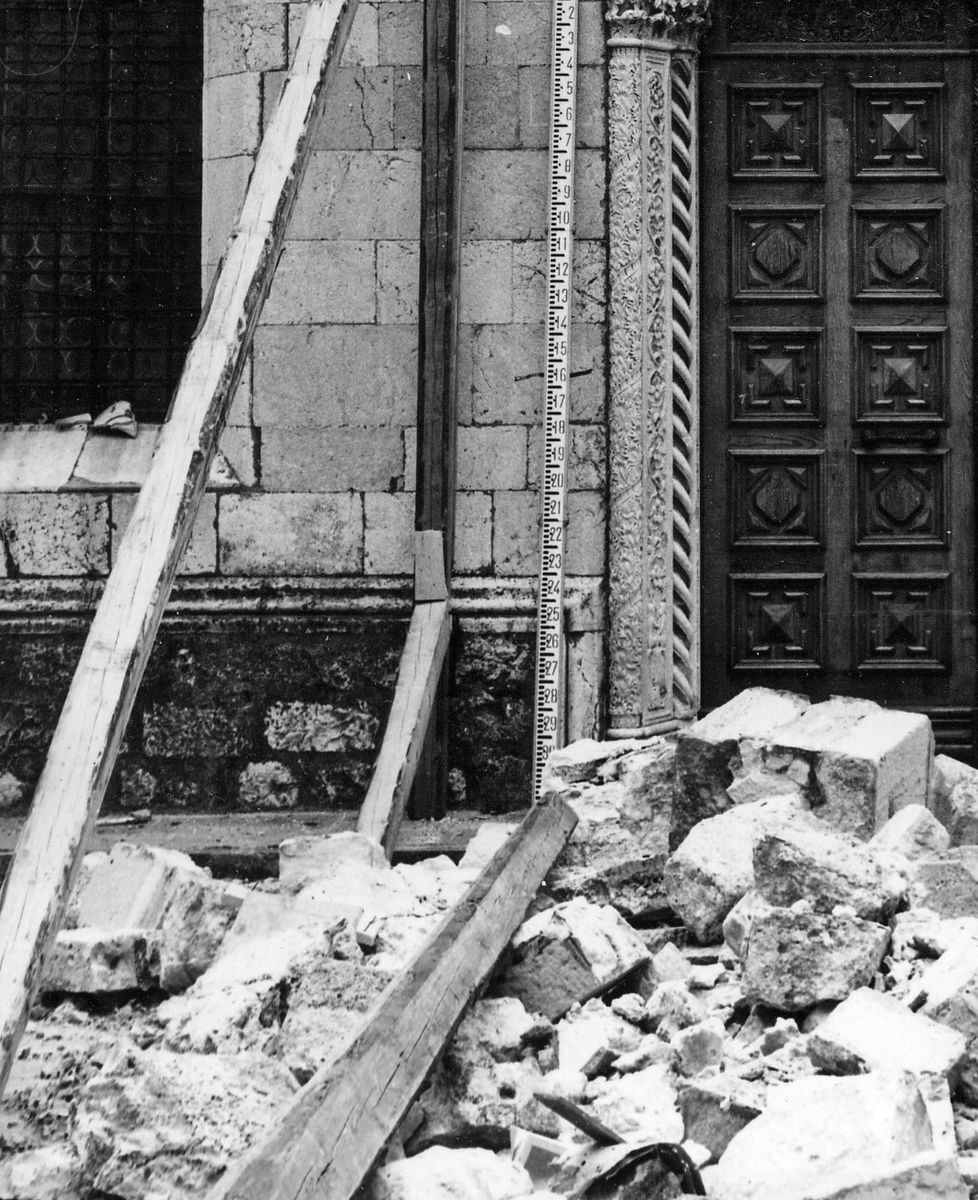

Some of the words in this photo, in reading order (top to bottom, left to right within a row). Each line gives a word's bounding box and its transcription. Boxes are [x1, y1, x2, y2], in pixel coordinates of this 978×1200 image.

[569, 6, 574, 19] 2
[568, 31, 574, 44] 3
[567, 57, 572, 68] 4
[567, 81, 572, 94] 5
[566, 108, 572, 121] 6
[566, 133, 571, 146] 7
[565, 160, 571, 172] 8
[564, 185, 570, 198] 9
[558, 211, 569, 224] 10
[557, 237, 566, 250] 11
[557, 262, 568, 276] 12
[556, 289, 567, 302] 13
[556, 315, 566, 329] 14
[555, 342, 566, 355] 15
[554, 368, 565, 381] 16
[554, 394, 565, 408] 17
[553, 420, 565, 434] 18
[552, 447, 564, 460] 19
[551, 474, 563, 487] 20
[551, 500, 560, 514] 21
[550, 527, 561, 541] 22
[549, 554, 561, 568] 23
[548, 580, 560, 594] 24
[547, 607, 559, 621] 25
[546, 633, 558, 648] 26
[546, 661, 557, 675] 27
[545, 689, 557, 703] 28
[544, 716, 556, 731] 29
